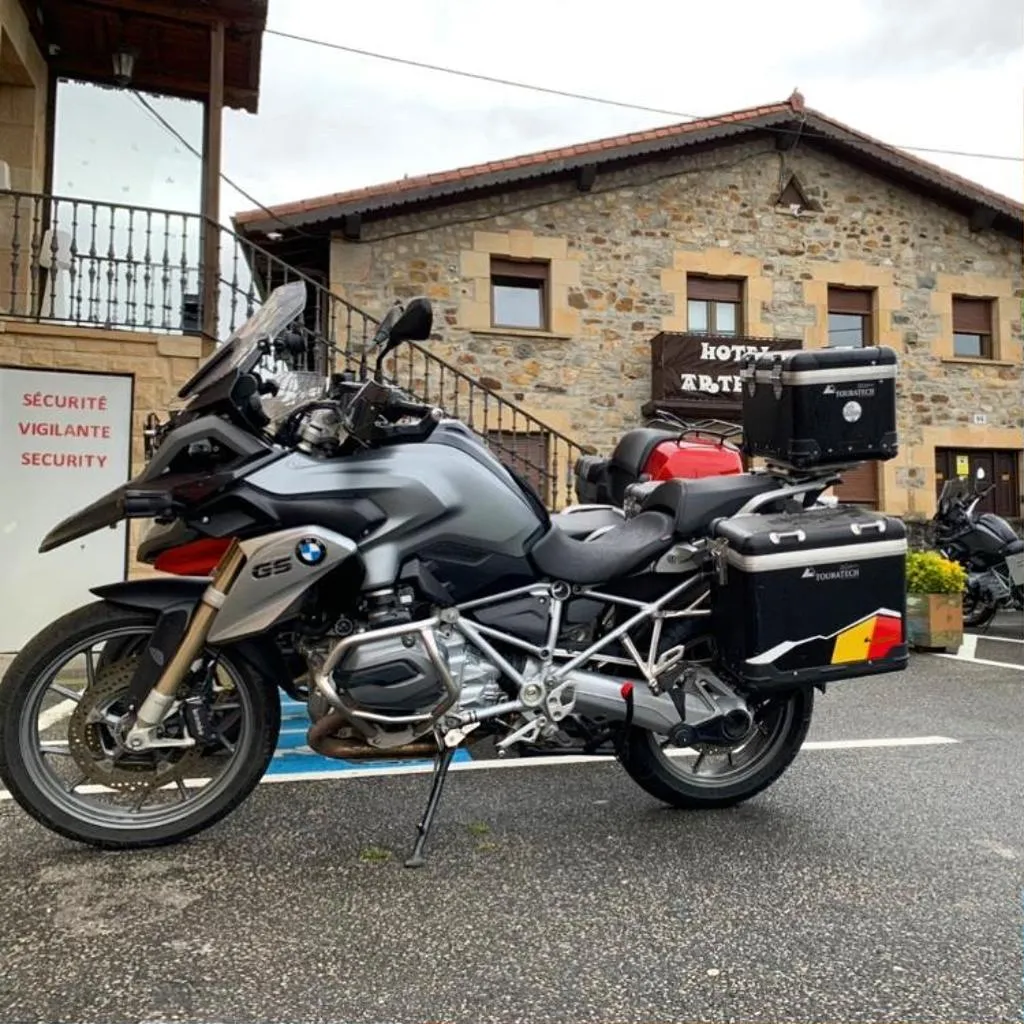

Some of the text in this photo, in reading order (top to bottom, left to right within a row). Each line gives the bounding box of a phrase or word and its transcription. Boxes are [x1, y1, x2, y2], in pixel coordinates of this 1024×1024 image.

[22, 391, 109, 411] SÉCURITÉ
[18, 420, 111, 439] VIGILANTE
[21, 452, 108, 468] SECURITY
[251, 556, 293, 579] GS
